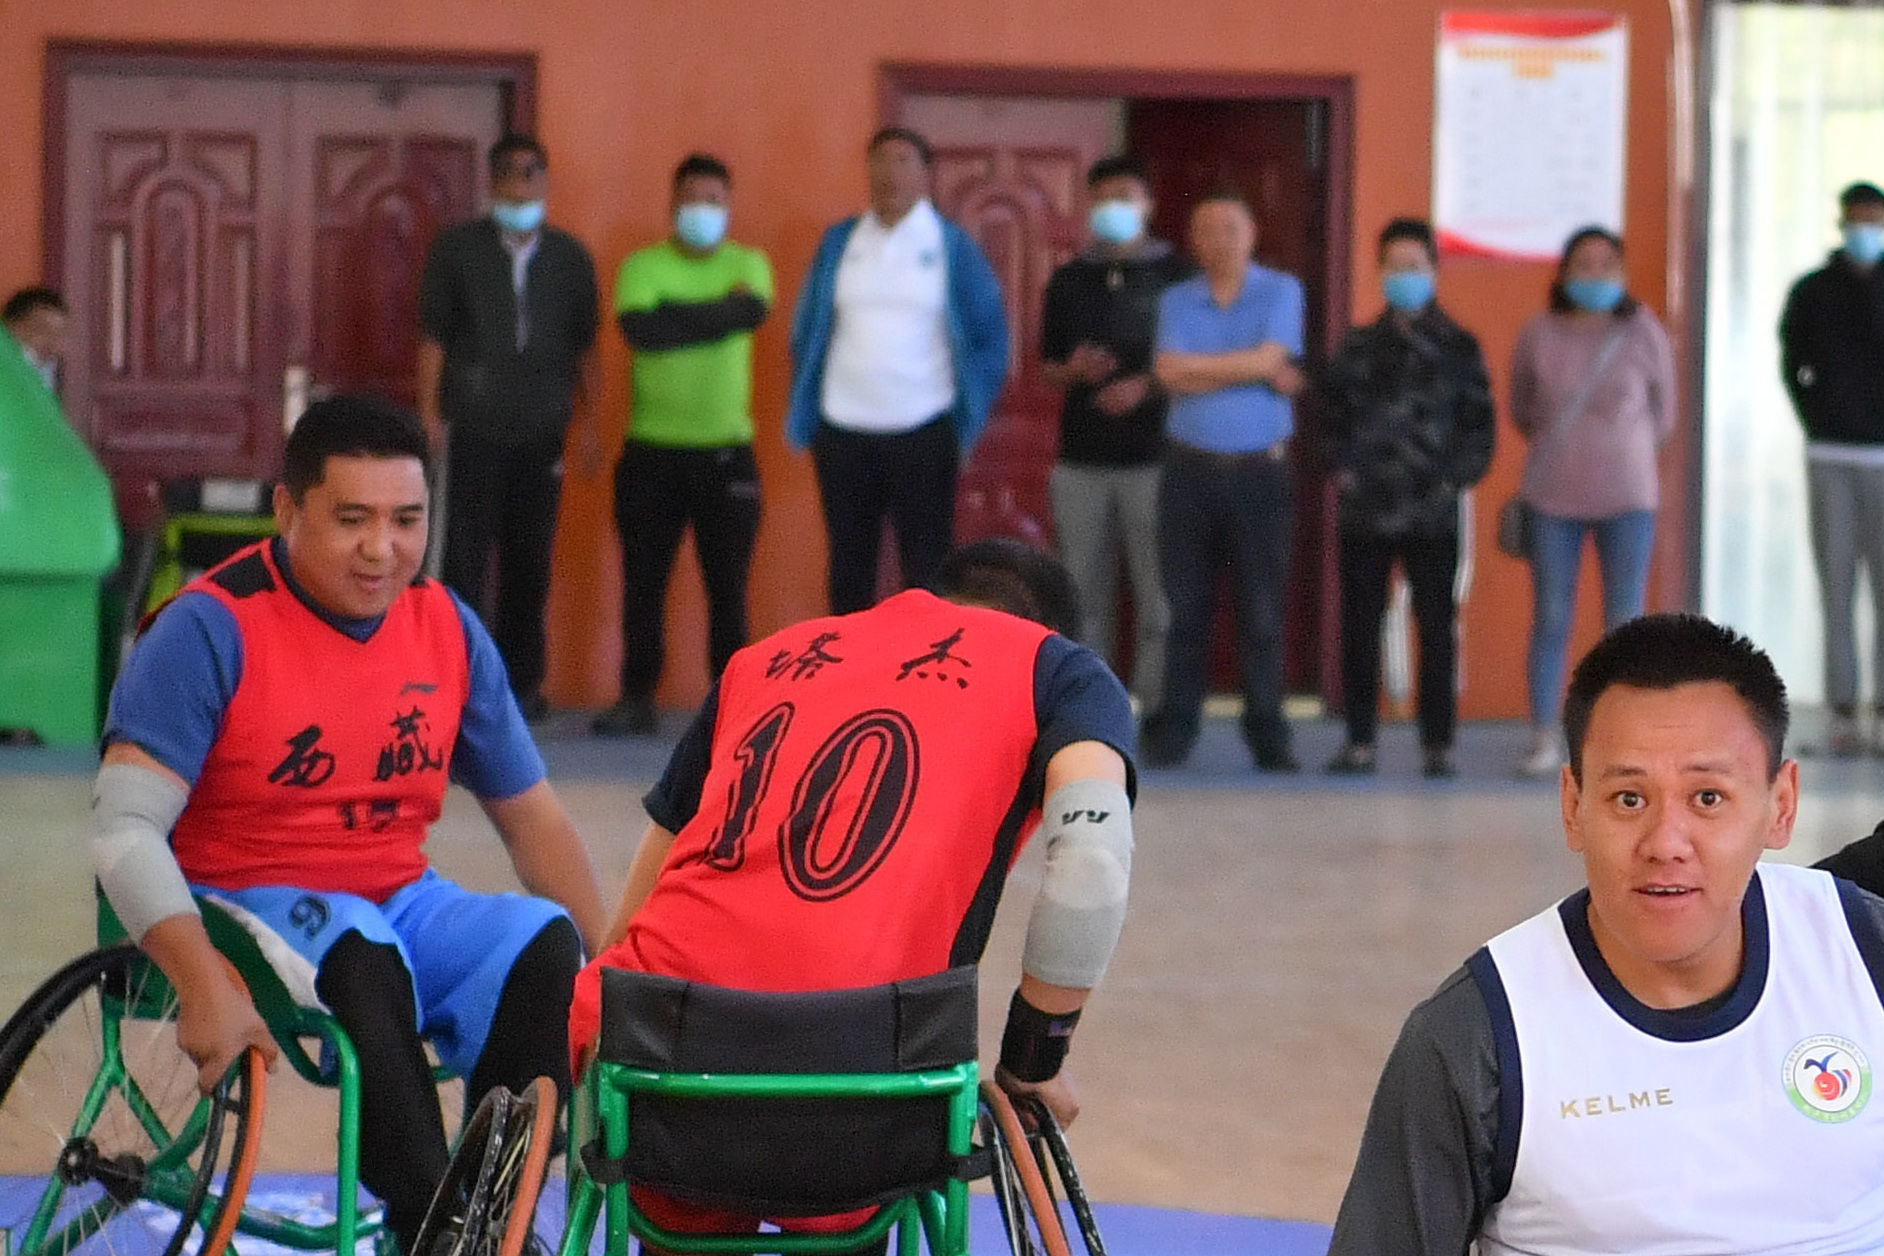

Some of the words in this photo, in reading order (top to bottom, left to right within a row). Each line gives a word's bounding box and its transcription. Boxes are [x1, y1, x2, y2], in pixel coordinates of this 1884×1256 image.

[267, 705, 443, 788] 西藏
[703, 701, 920, 902] 10
[1560, 1088, 1674, 1120] KELME
